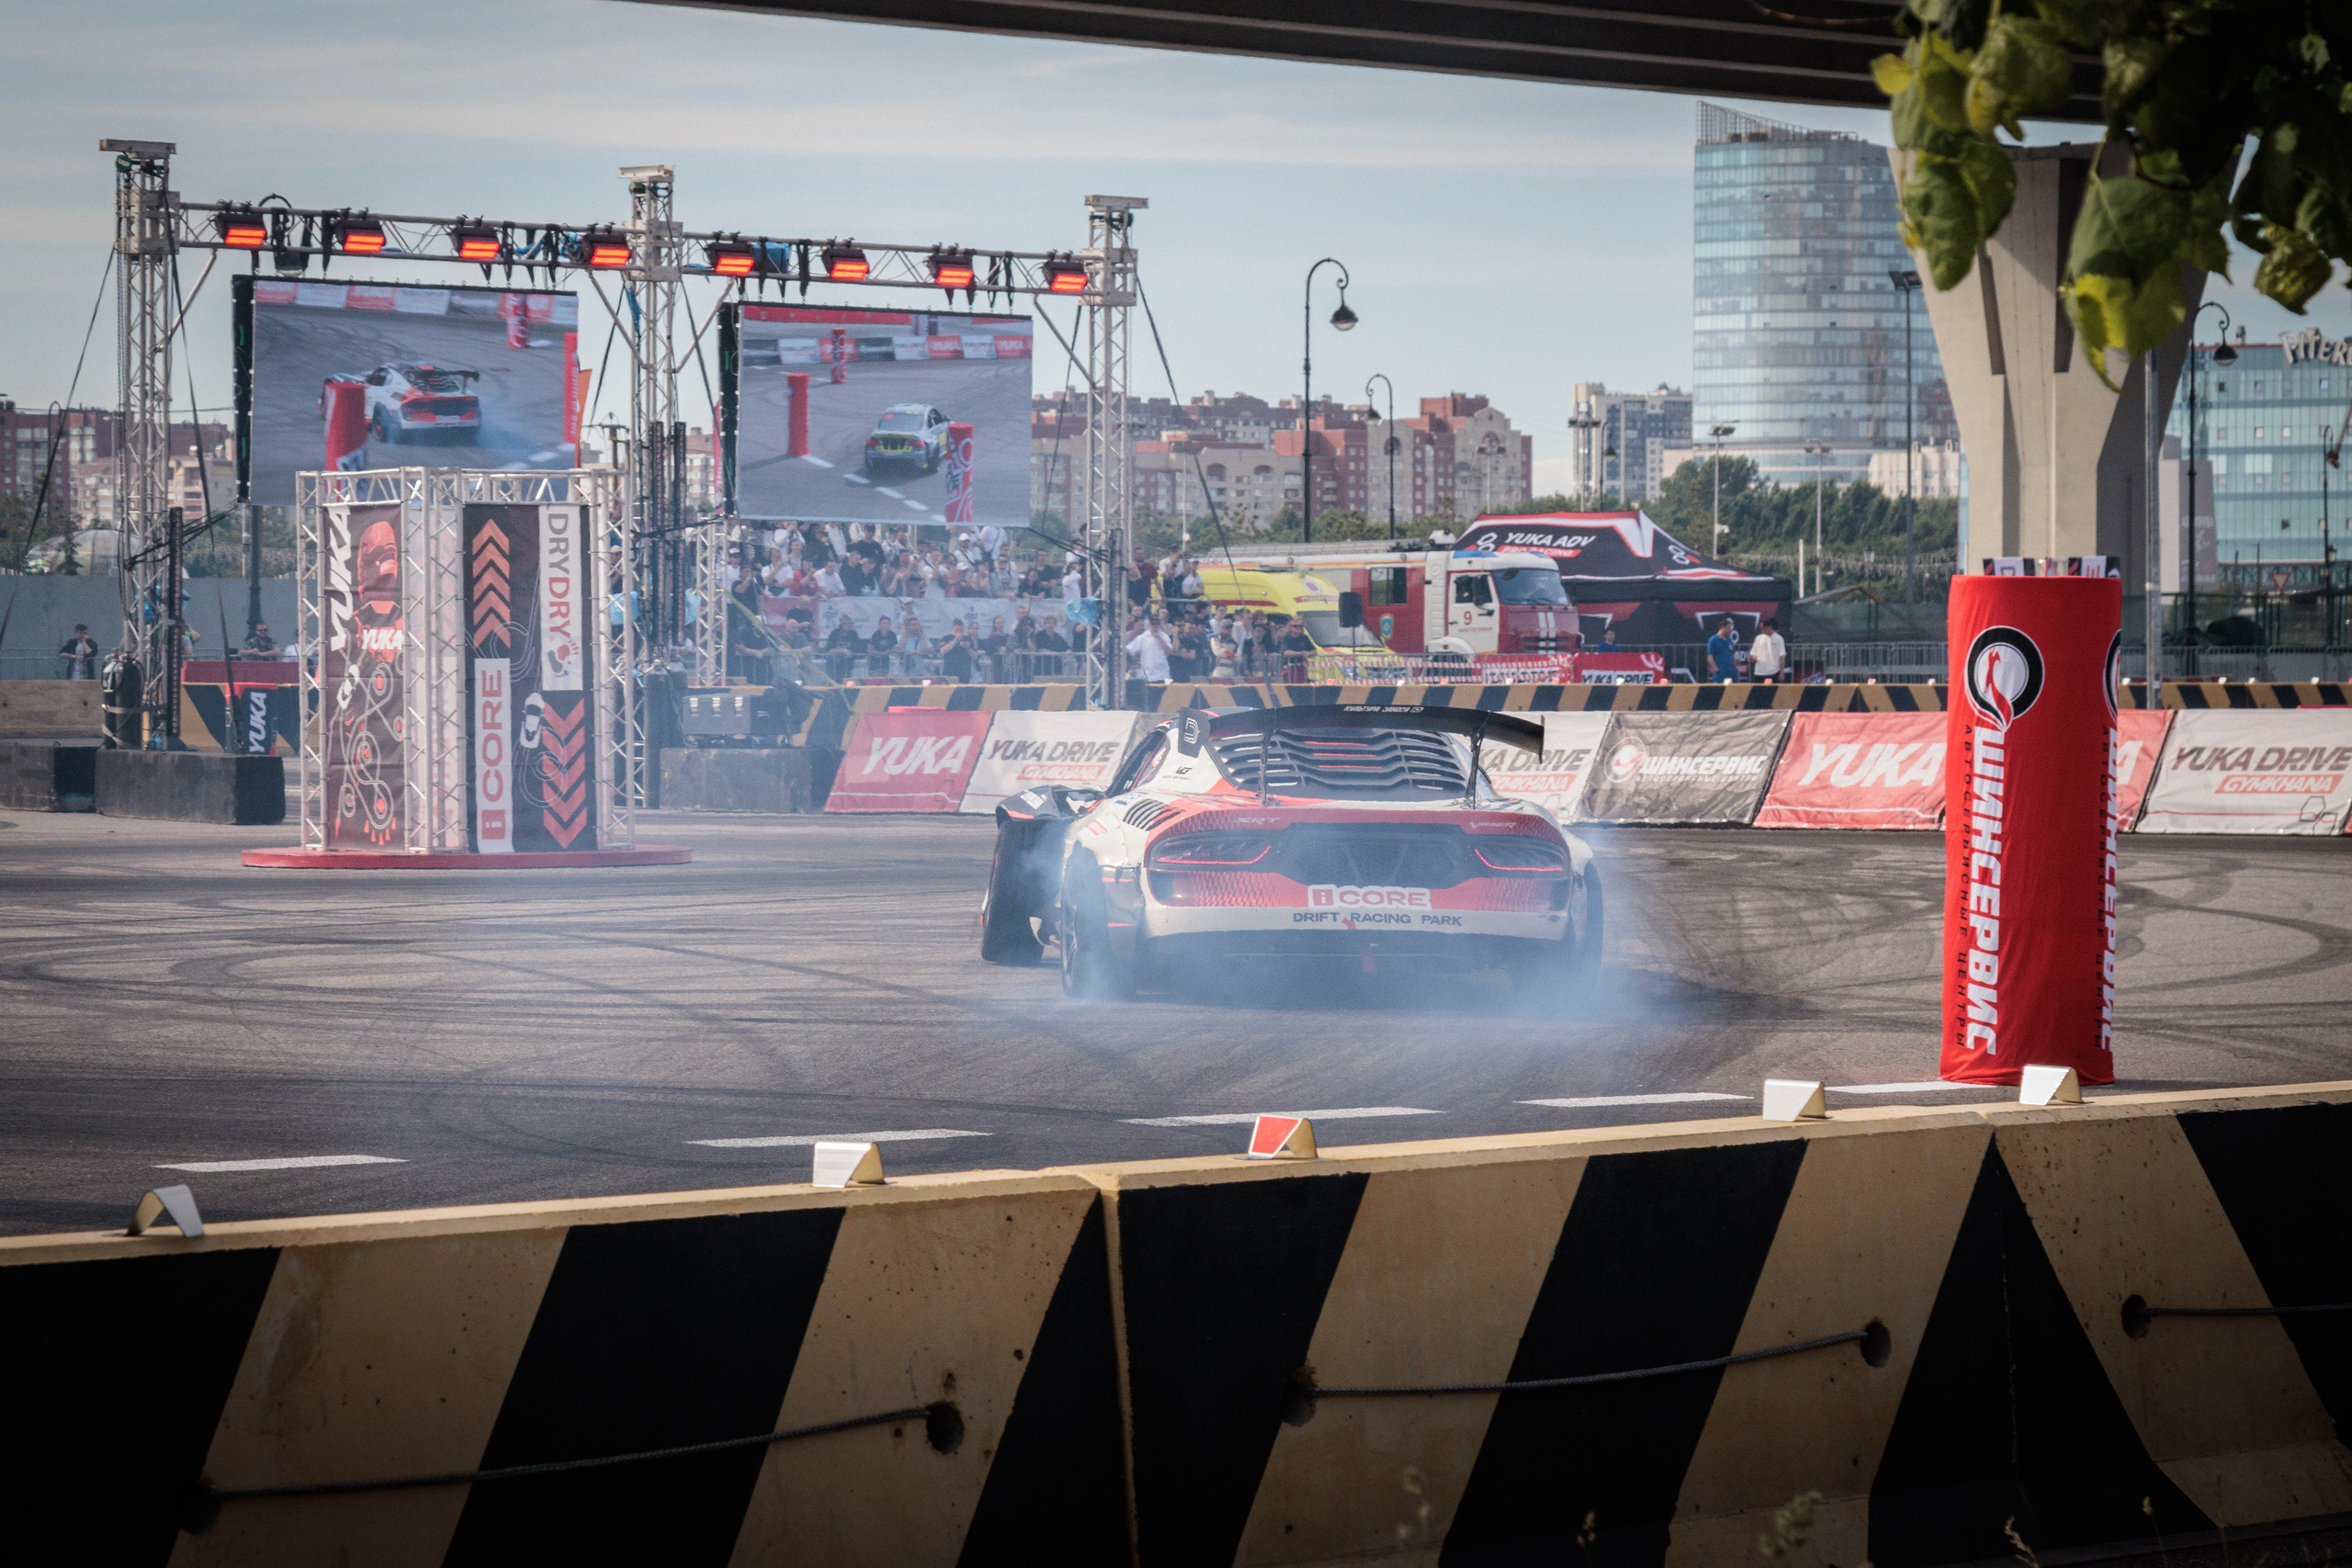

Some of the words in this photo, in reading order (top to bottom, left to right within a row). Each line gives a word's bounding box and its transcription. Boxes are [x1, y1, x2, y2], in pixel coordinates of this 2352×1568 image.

[1505, 532, 1553, 547] YUKA
[1552, 535, 1597, 548] ADV
[328, 505, 353, 651] YUKA
[548, 513, 571, 639] DRYDRY
[1464, 610, 1473, 626] 9
[361, 628, 403, 650] YUKA
[249, 691, 266, 752] YUKA
[862, 736, 975, 775] YUKA
[987, 739, 1050, 761] YUKA
[1045, 741, 1121, 763] DRIVE
[2171, 747, 2256, 771] YUKA
[2254, 747, 2352, 771] DRIVE
[1639, 755, 1769, 775] ШИНСЕРВИС
[1798, 742, 1947, 787] YUKA
[1492, 774, 1568, 791] YMKHANA
[2223, 775, 2333, 792] GYMKHANA
[1959, 724, 1973, 937] АВТОСЕРВИСНЫЕ
[1966, 726, 2005, 1055] ШИНСЕРВИС
[1293, 912, 1340, 923] DRIFT
[1350, 912, 1412, 924] RACING
[1420, 914, 1463, 927] PARK
[1956, 952, 1968, 1047] ЦЕНТРЫ
